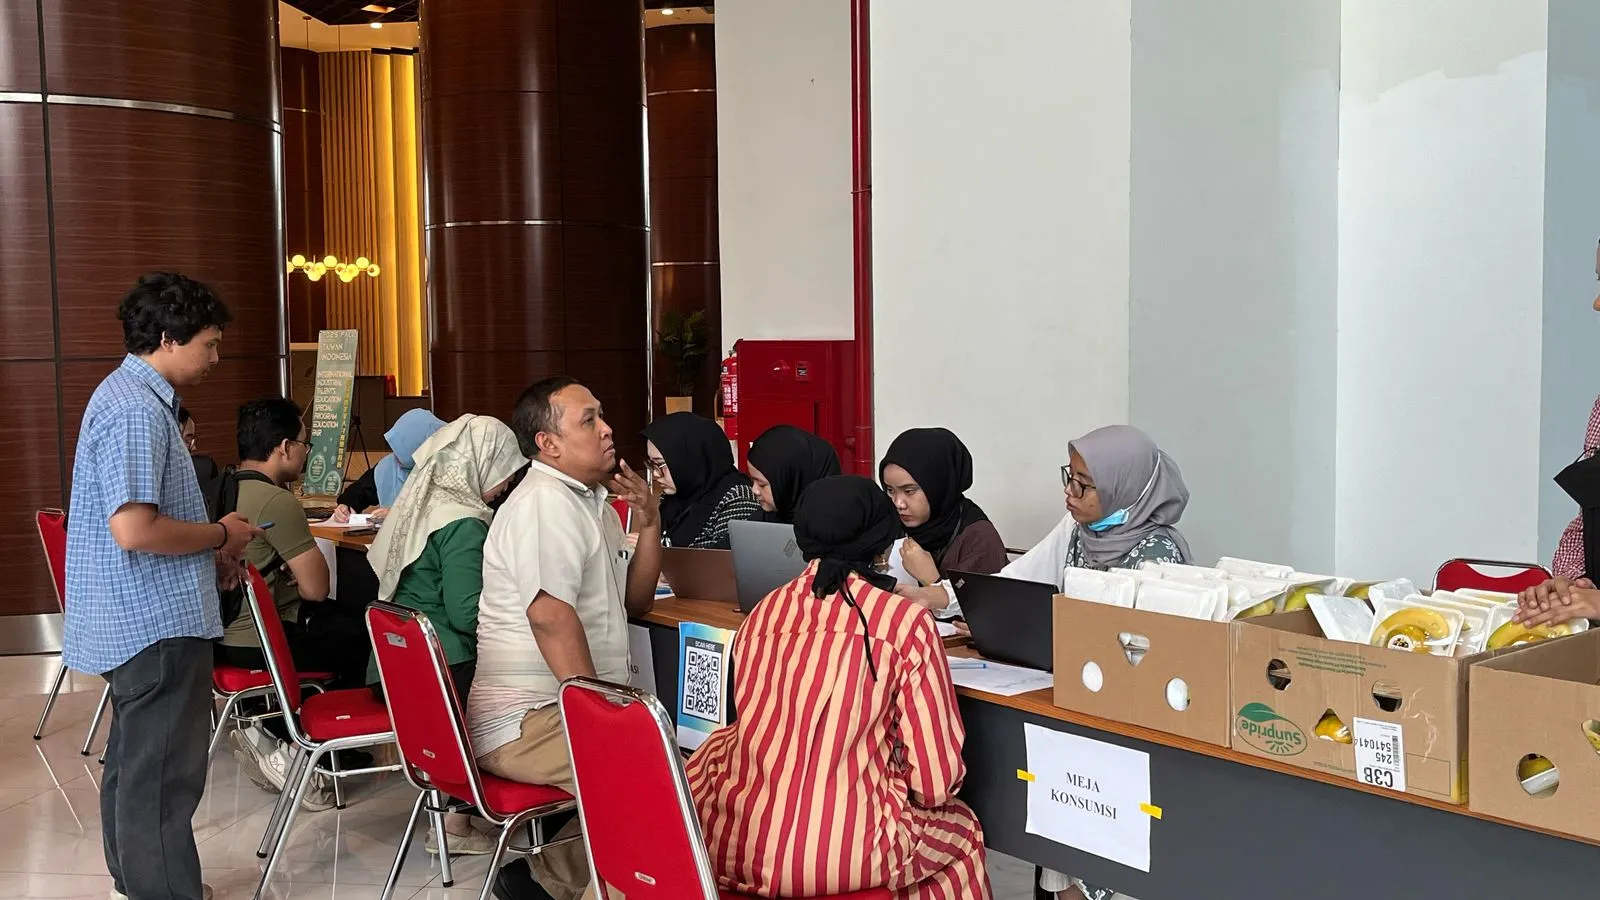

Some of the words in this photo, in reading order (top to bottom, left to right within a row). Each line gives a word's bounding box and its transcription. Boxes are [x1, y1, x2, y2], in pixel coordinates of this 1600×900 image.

[322, 343, 343, 351] TAIWAN
[321, 352, 352, 361] INDONESIA
[313, 412, 337, 420] PROGRAM
[694, 640, 706, 649] SCAN
[706, 642, 716, 651] HERE
[1241, 720, 1301, 745] Sunpride
[1376, 752, 1392, 764] 245
[1066, 772, 1100, 793] MEJA
[1364, 767, 1393, 787] C3B
[1051, 788, 1117, 819] KONSUMSI
